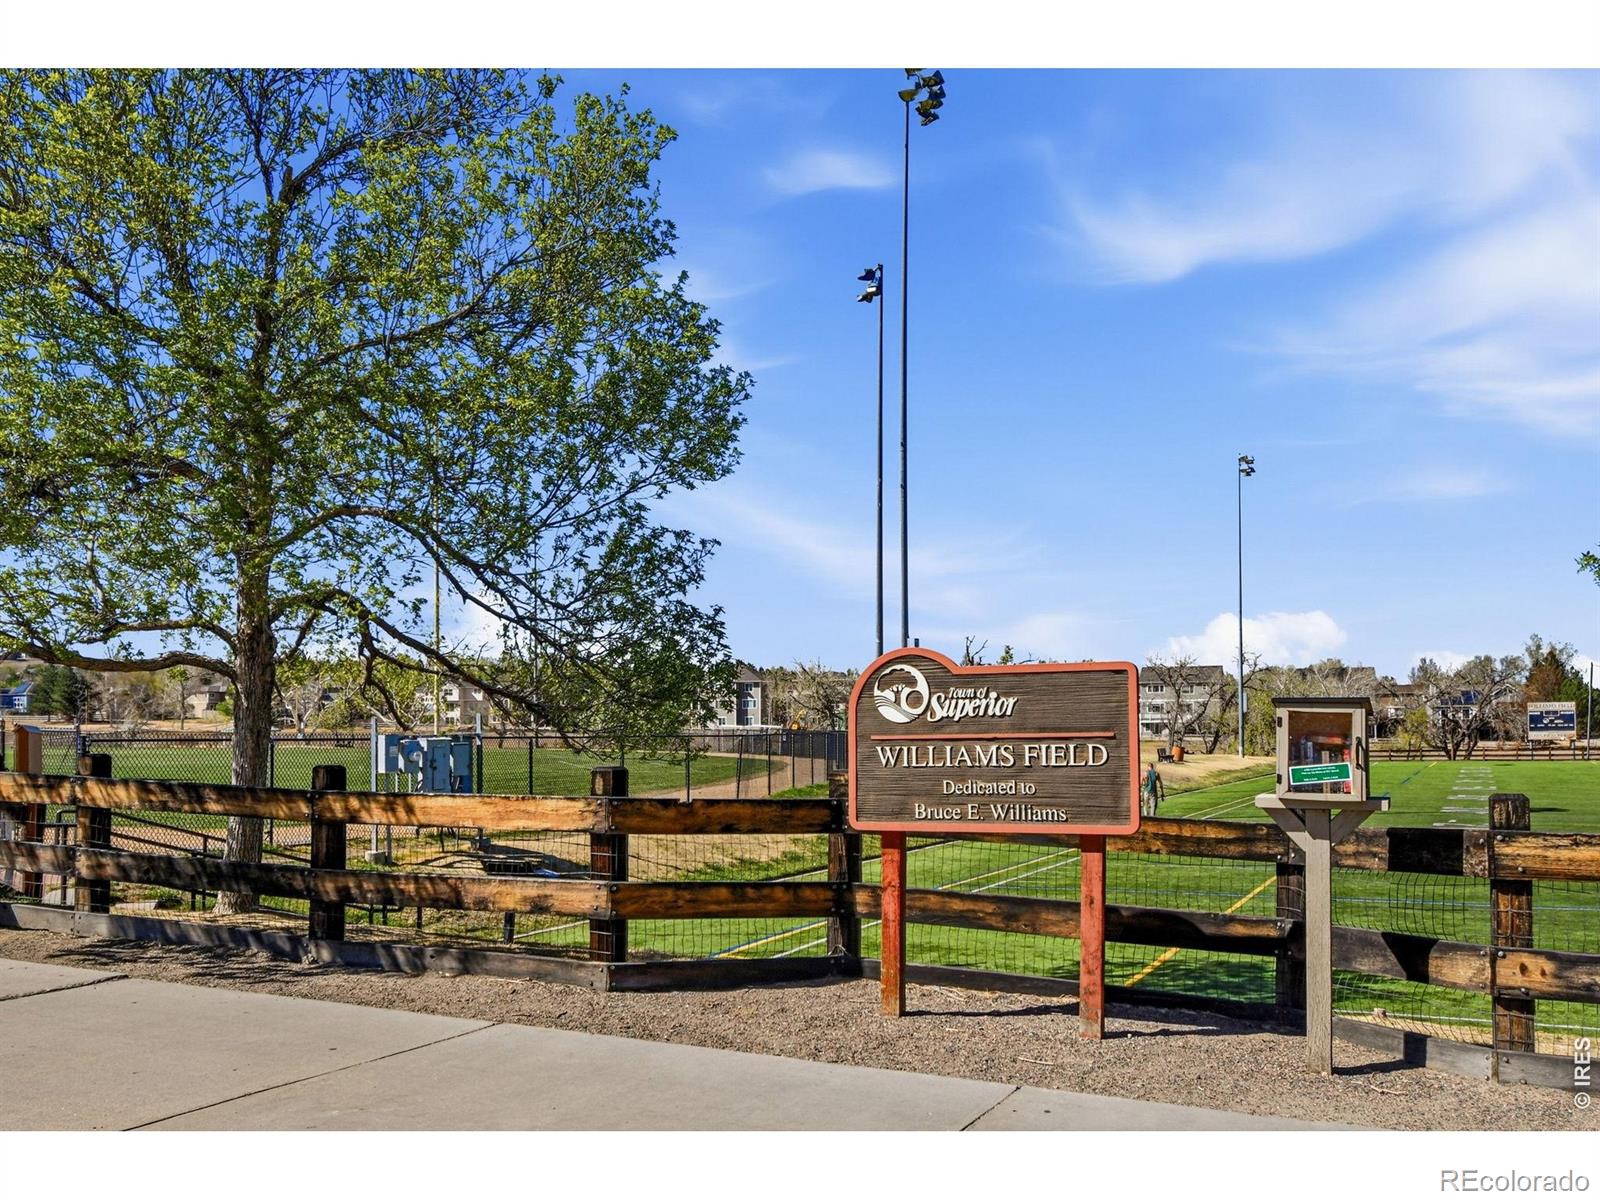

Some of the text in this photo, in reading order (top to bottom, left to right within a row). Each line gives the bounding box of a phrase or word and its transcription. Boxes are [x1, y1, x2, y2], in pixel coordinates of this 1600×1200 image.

[949, 687, 988, 699] Town of
[927, 691, 1018, 722] Superior
[875, 743, 1109, 768] WILLIAMS FIELD
[943, 780, 1036, 795] Dedicated to
[914, 803, 1067, 821] Bruce E. Williams
